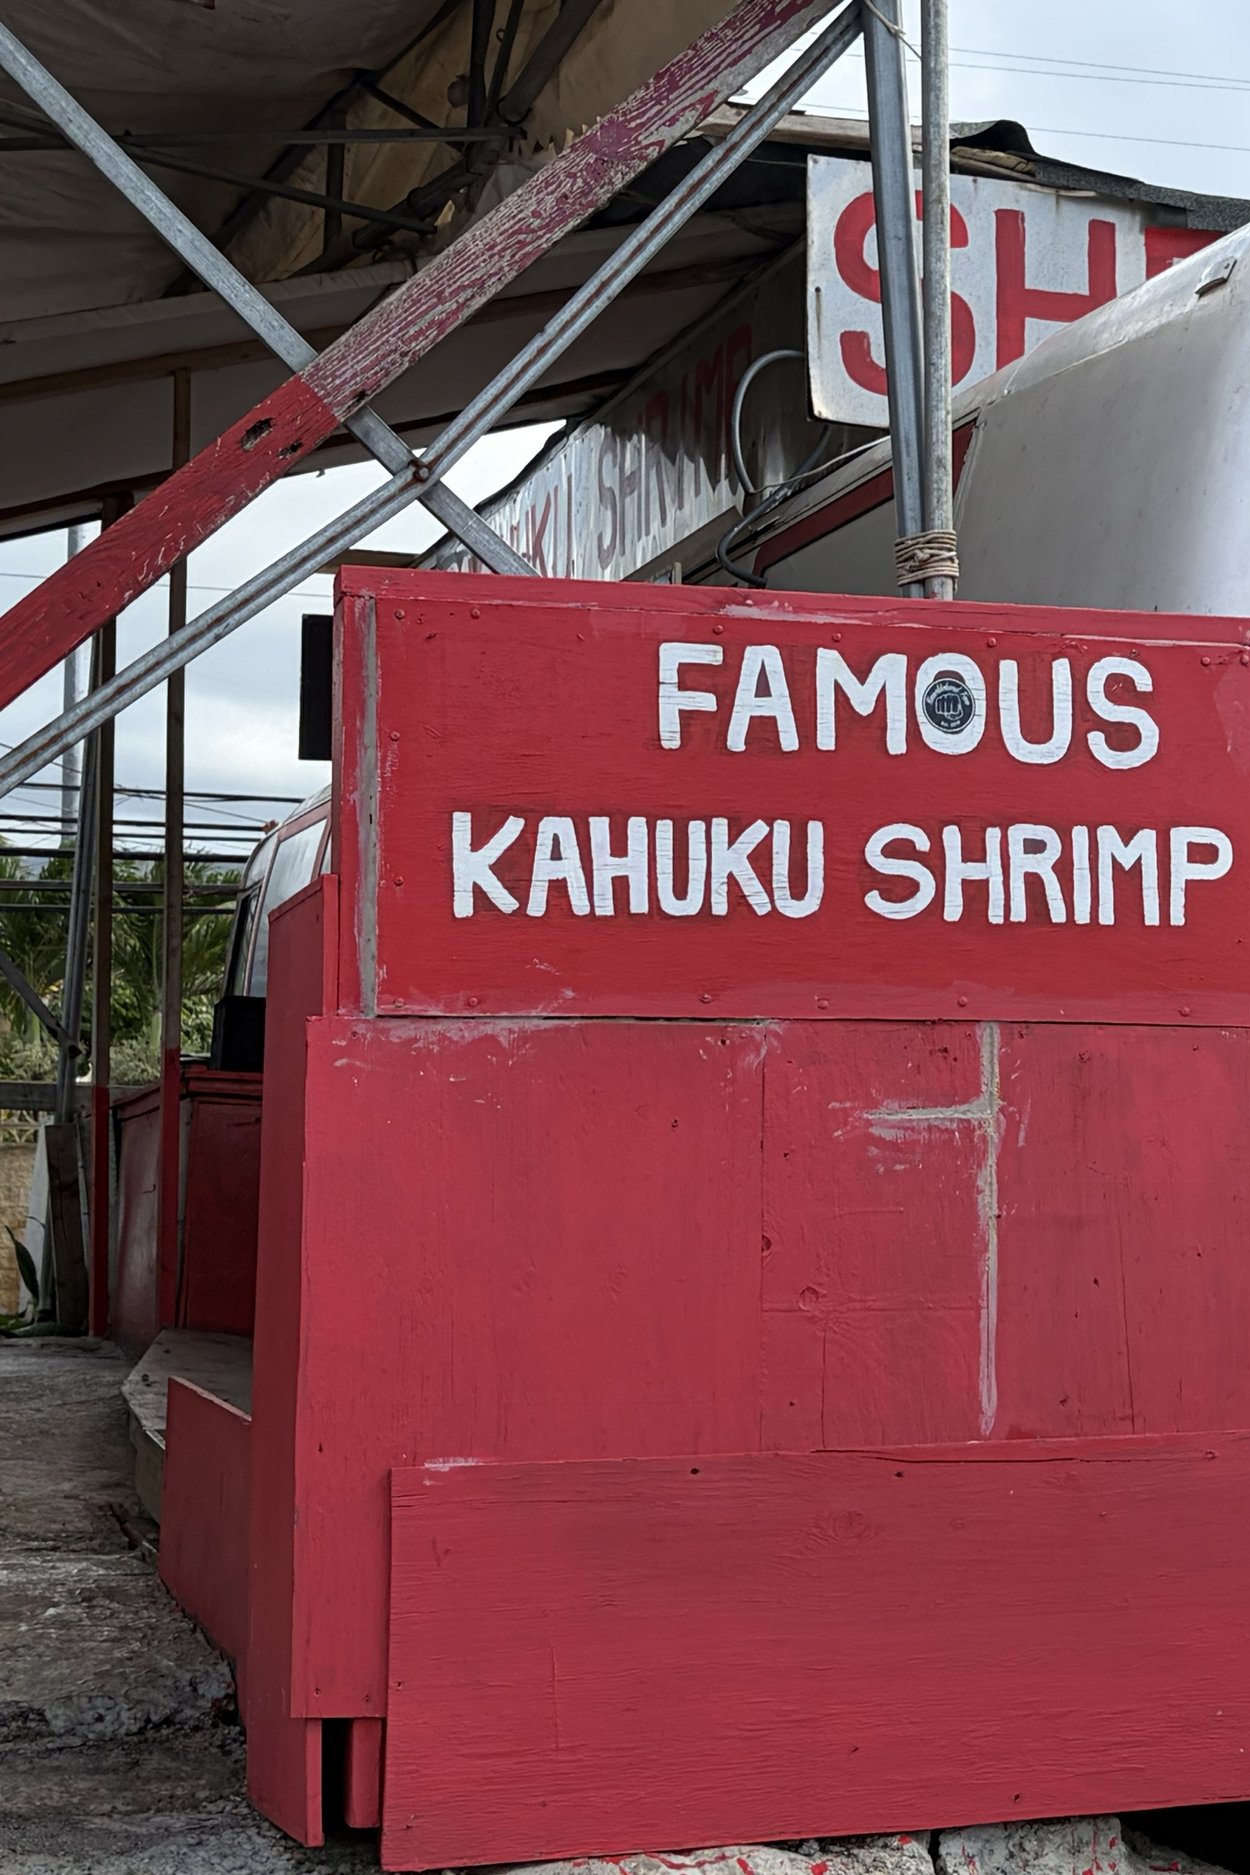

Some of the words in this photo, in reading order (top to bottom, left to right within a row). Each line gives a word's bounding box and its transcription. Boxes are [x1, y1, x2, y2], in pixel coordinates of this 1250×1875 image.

[657, 642, 1161, 769] FAMOUS
[451, 811, 825, 919] KAHUKU
[864, 822, 1234, 927] SHRIMP
